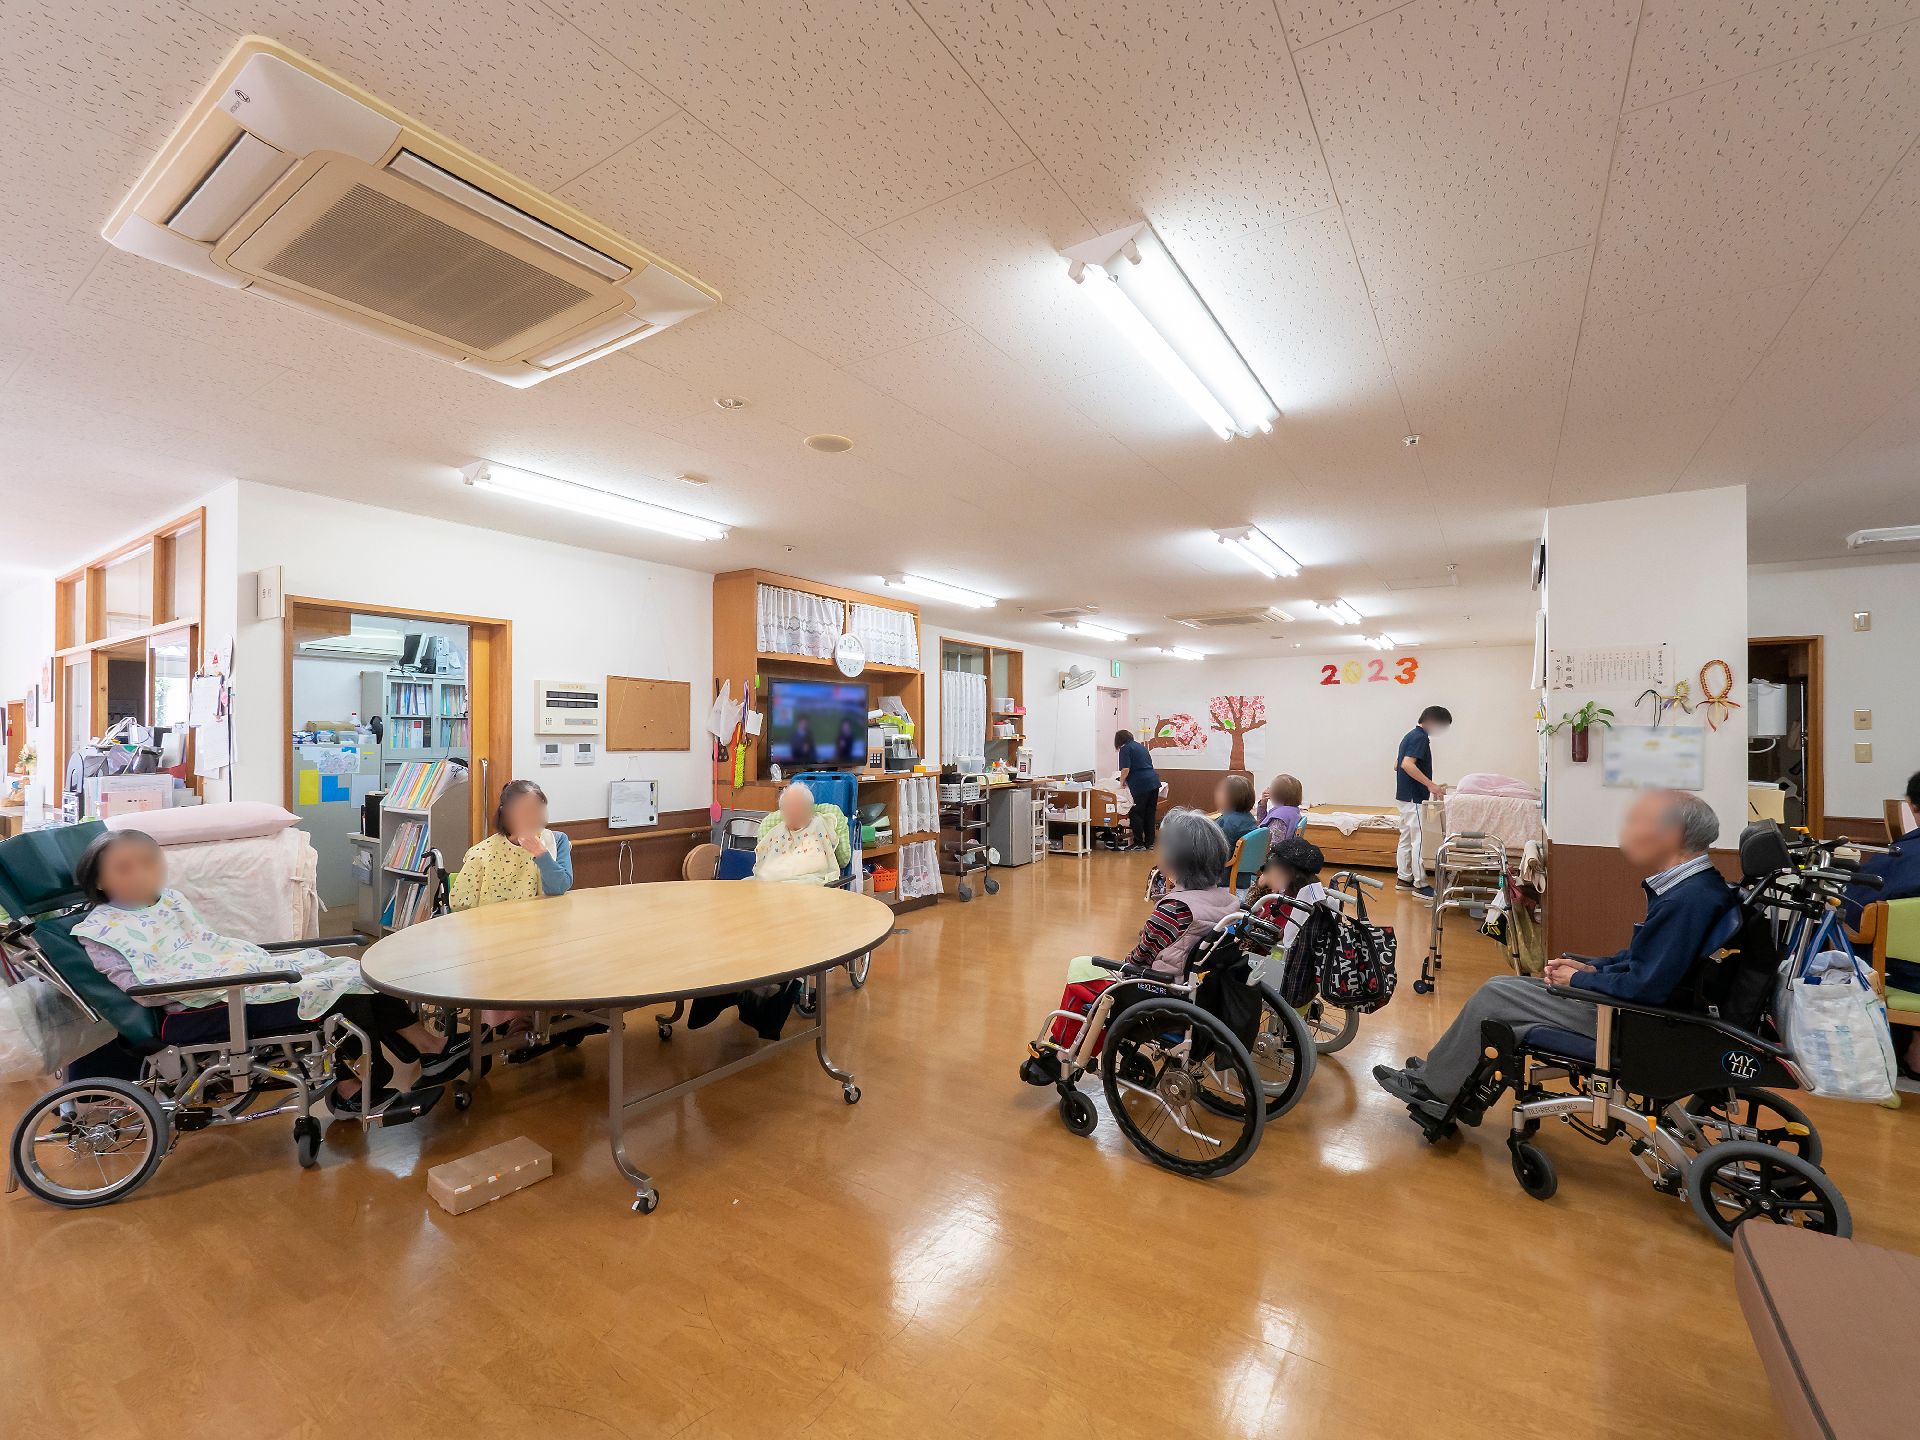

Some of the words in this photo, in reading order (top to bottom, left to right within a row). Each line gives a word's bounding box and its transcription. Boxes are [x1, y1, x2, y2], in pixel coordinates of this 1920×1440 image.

[1320, 657, 1419, 685] 2023
[1728, 1052, 1754, 1067] MY
[1731, 1061, 1758, 1078] TILT
